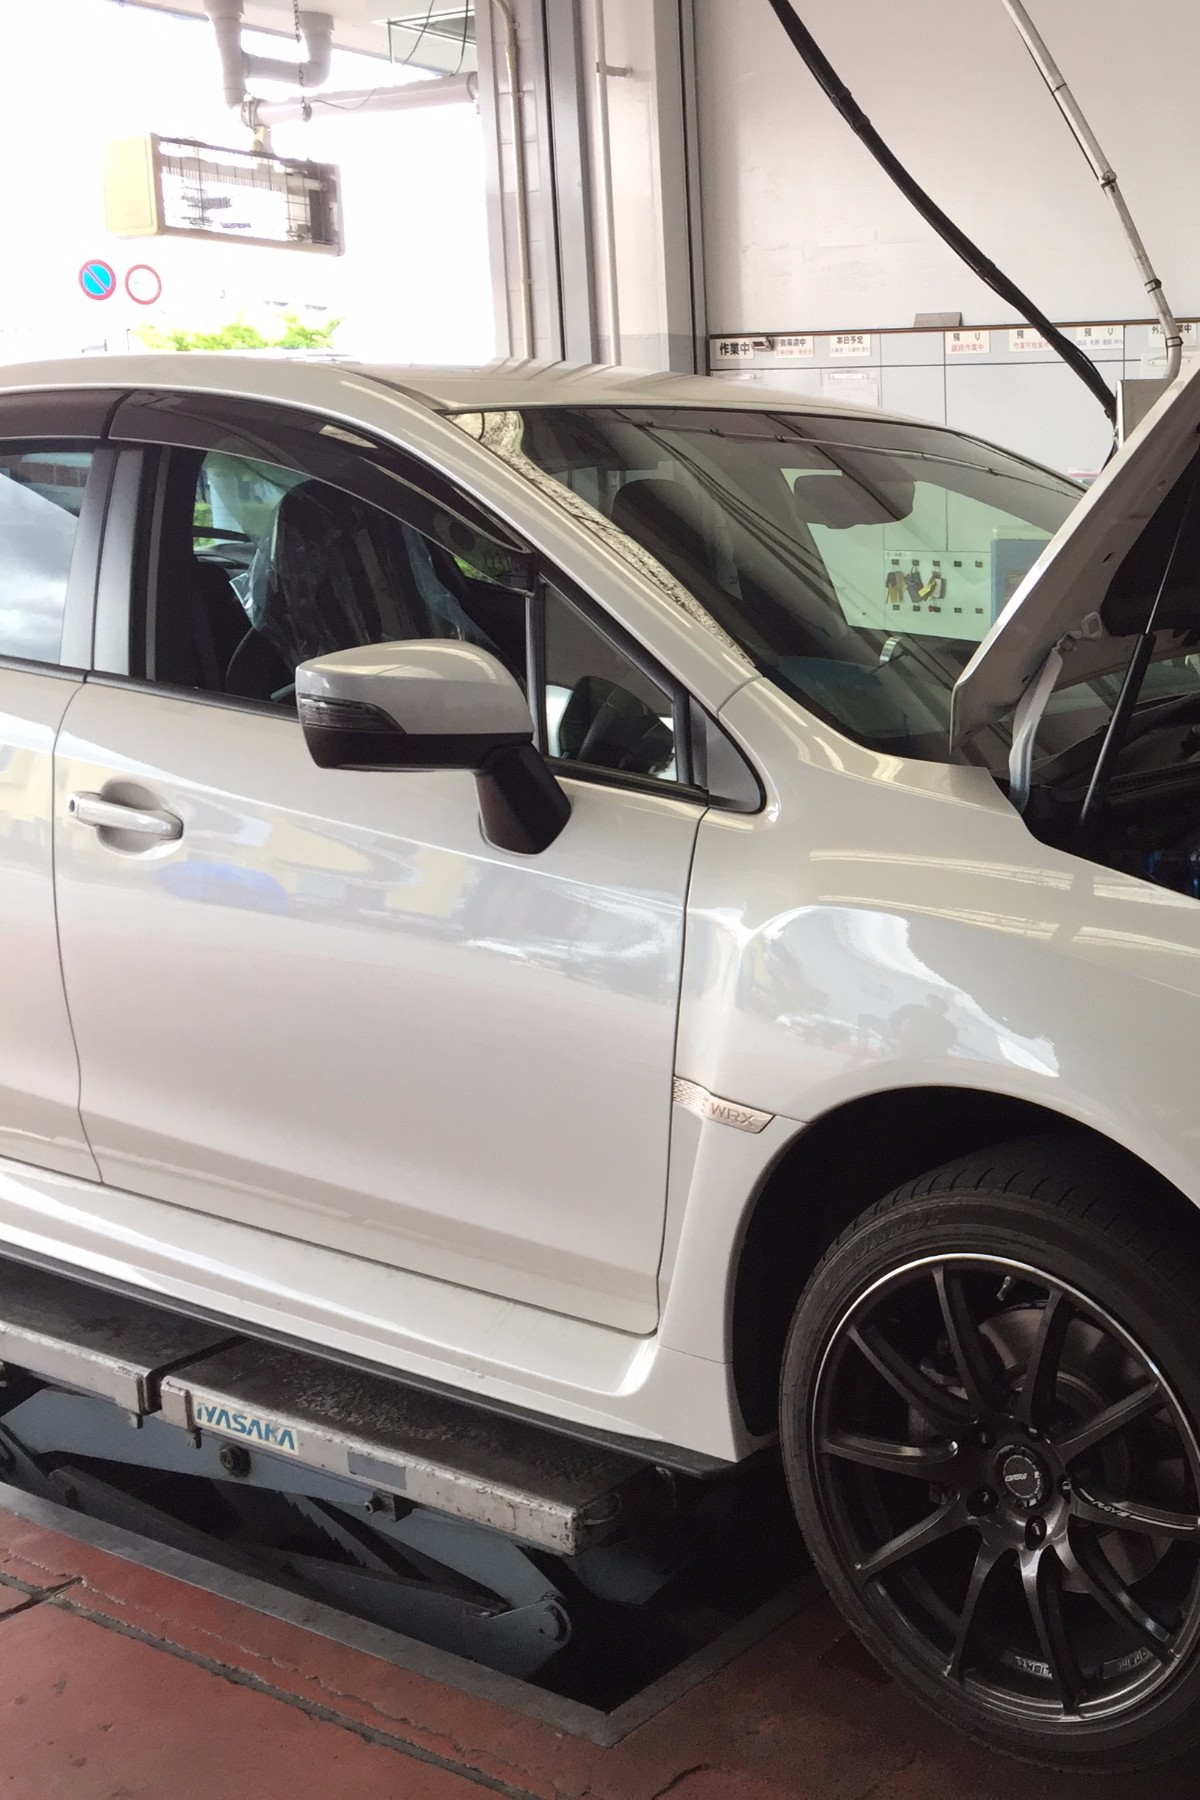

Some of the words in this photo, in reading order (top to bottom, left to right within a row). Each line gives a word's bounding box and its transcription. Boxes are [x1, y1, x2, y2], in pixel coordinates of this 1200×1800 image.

[719, 342, 750, 356] 作業中
[710, 1102, 755, 1126] WRX
